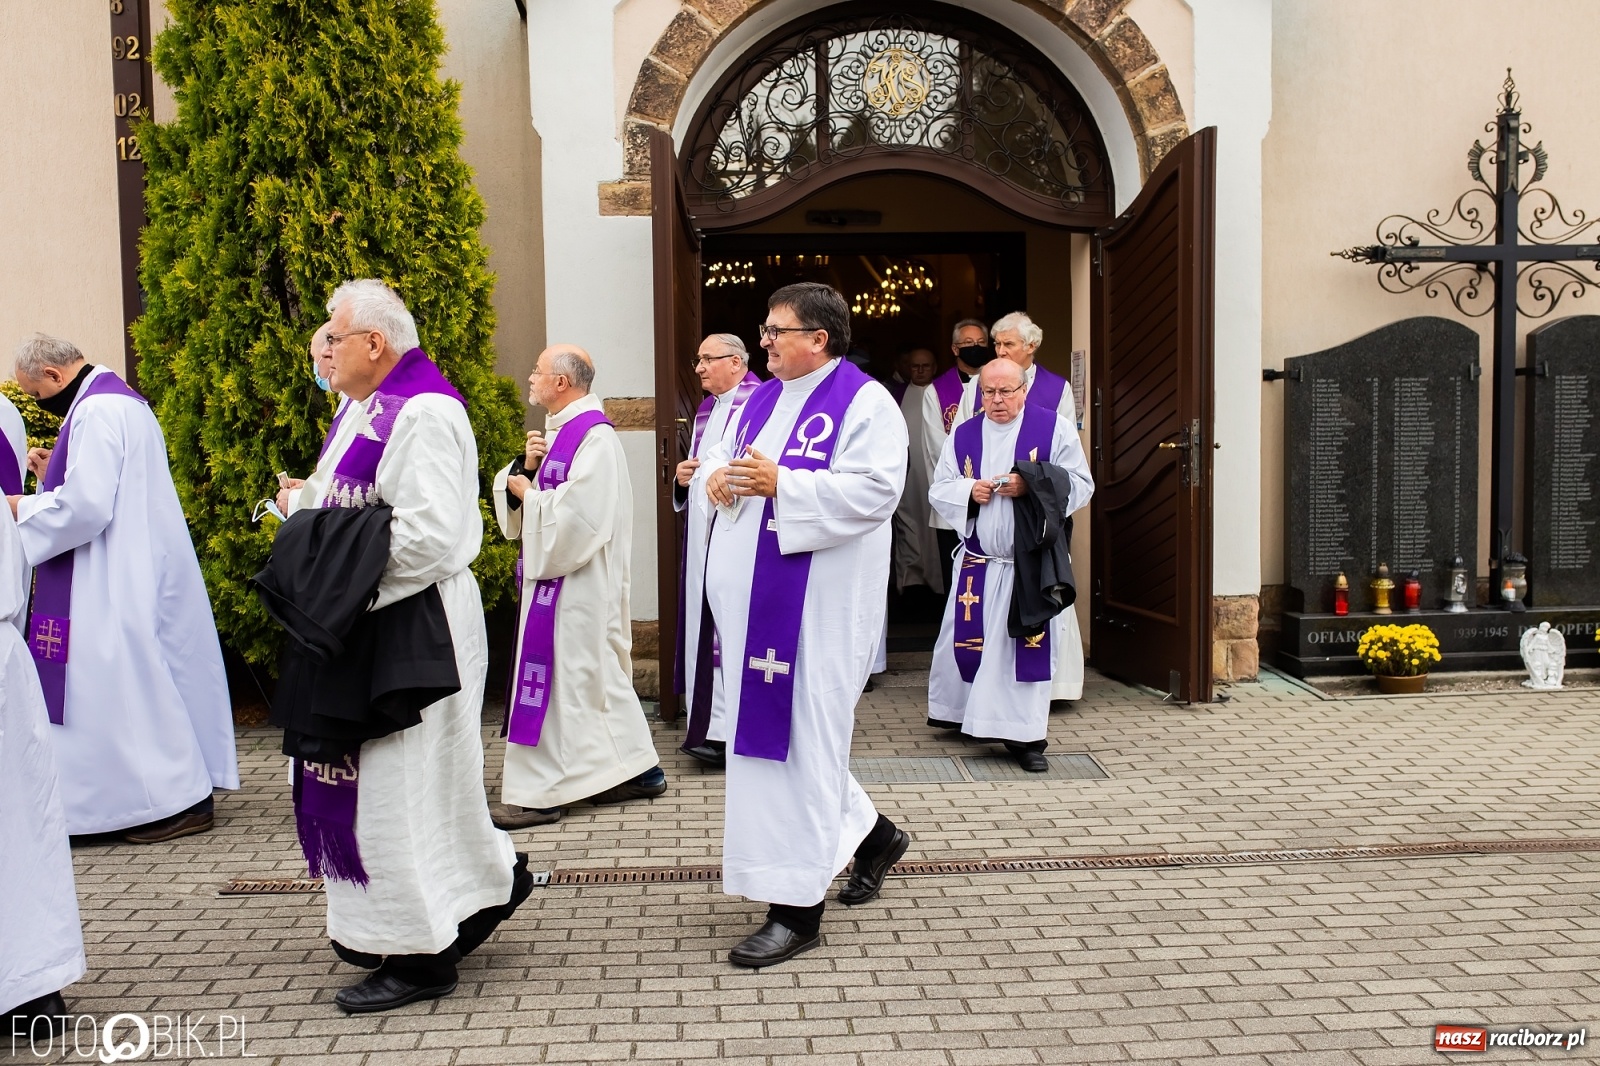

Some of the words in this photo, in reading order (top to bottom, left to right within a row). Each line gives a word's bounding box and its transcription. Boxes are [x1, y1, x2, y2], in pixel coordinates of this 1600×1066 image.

[112, 35, 140, 61] 92
[114, 92, 141, 117] 02
[117, 136, 142, 161] 12
